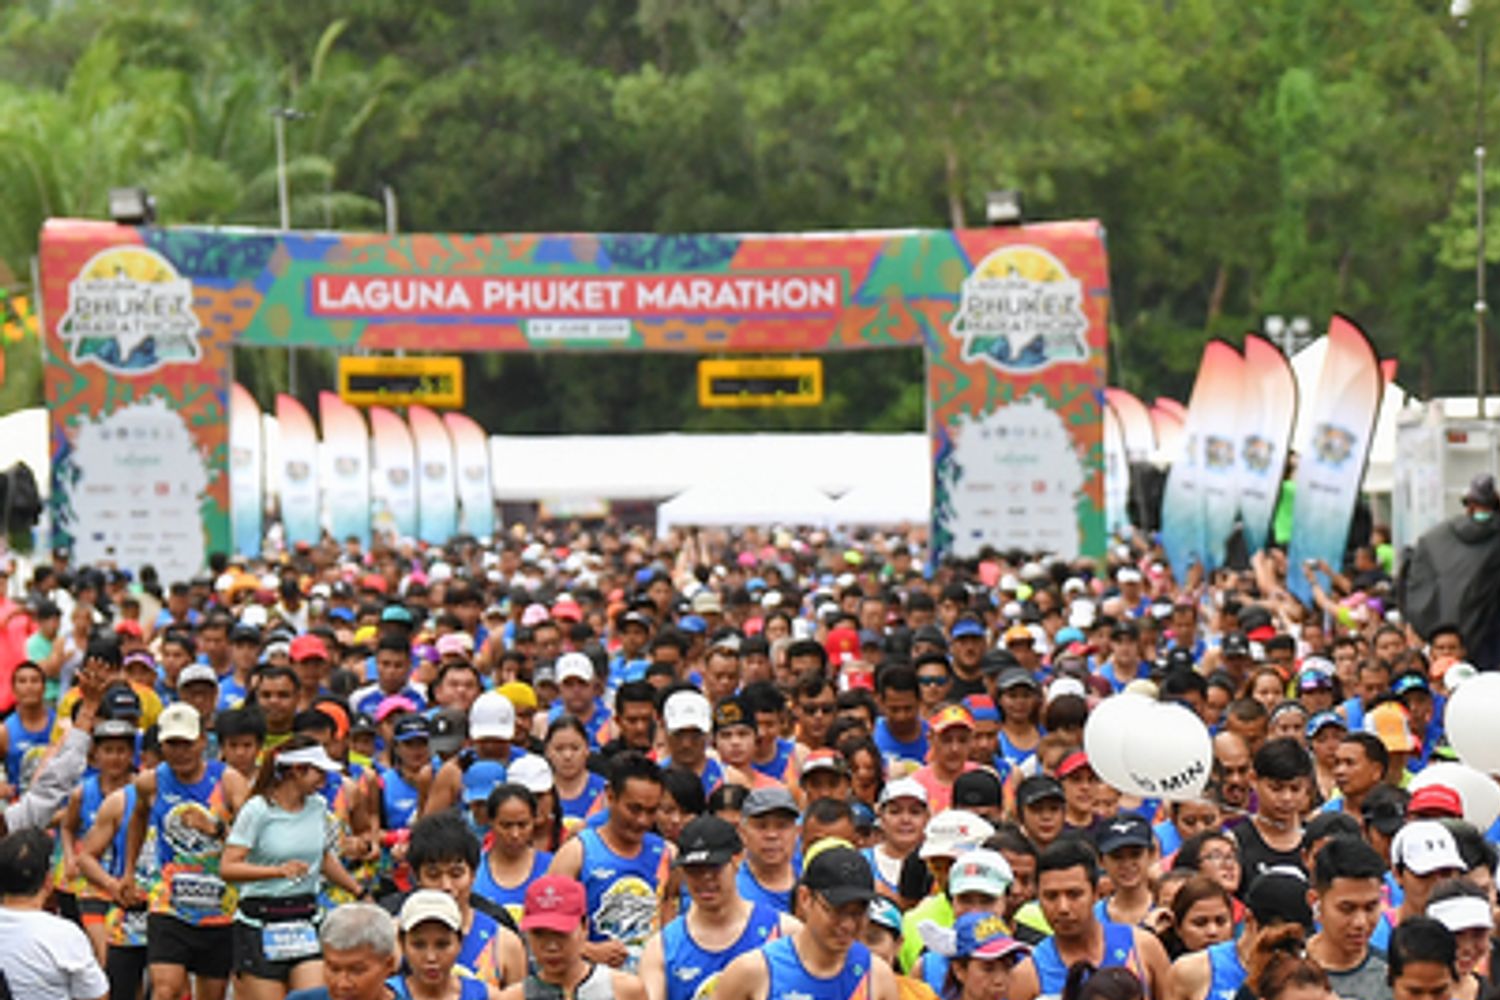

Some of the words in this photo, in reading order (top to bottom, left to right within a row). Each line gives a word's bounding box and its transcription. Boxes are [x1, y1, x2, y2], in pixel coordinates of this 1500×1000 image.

[318, 278, 471, 309] LAGUNA
[483, 277, 624, 309] PHUKET
[636, 277, 837, 309] MARATHON
[1160, 759, 1205, 791] MIN
